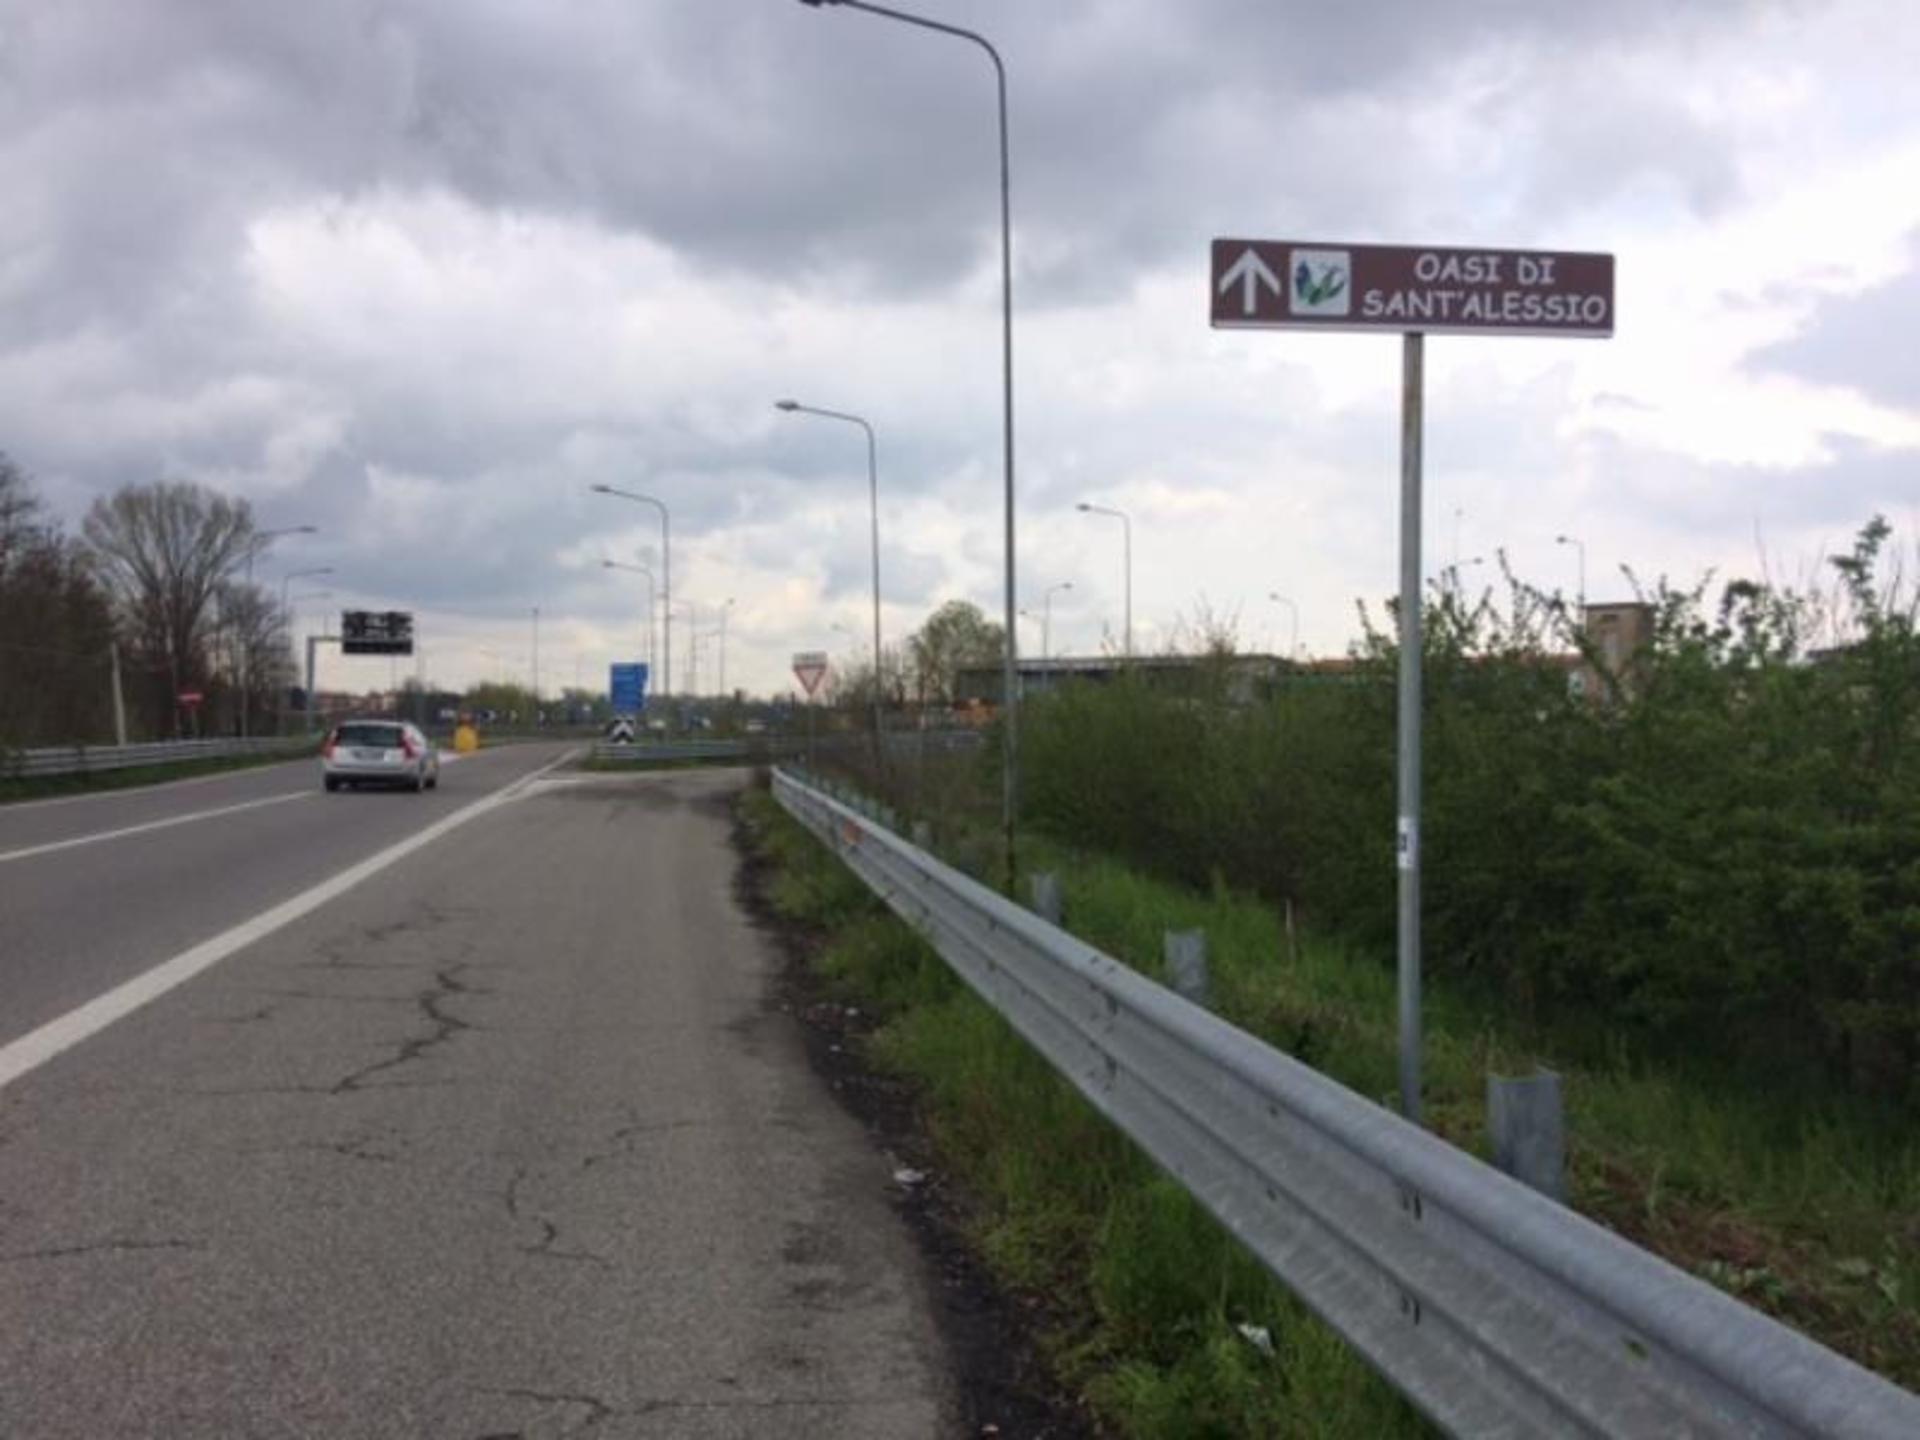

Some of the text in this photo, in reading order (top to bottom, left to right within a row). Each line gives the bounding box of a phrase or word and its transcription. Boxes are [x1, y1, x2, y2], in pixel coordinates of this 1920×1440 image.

[1415, 253, 1555, 286] OASI DI
[1361, 289, 1607, 324] SANT'ALESSIO
